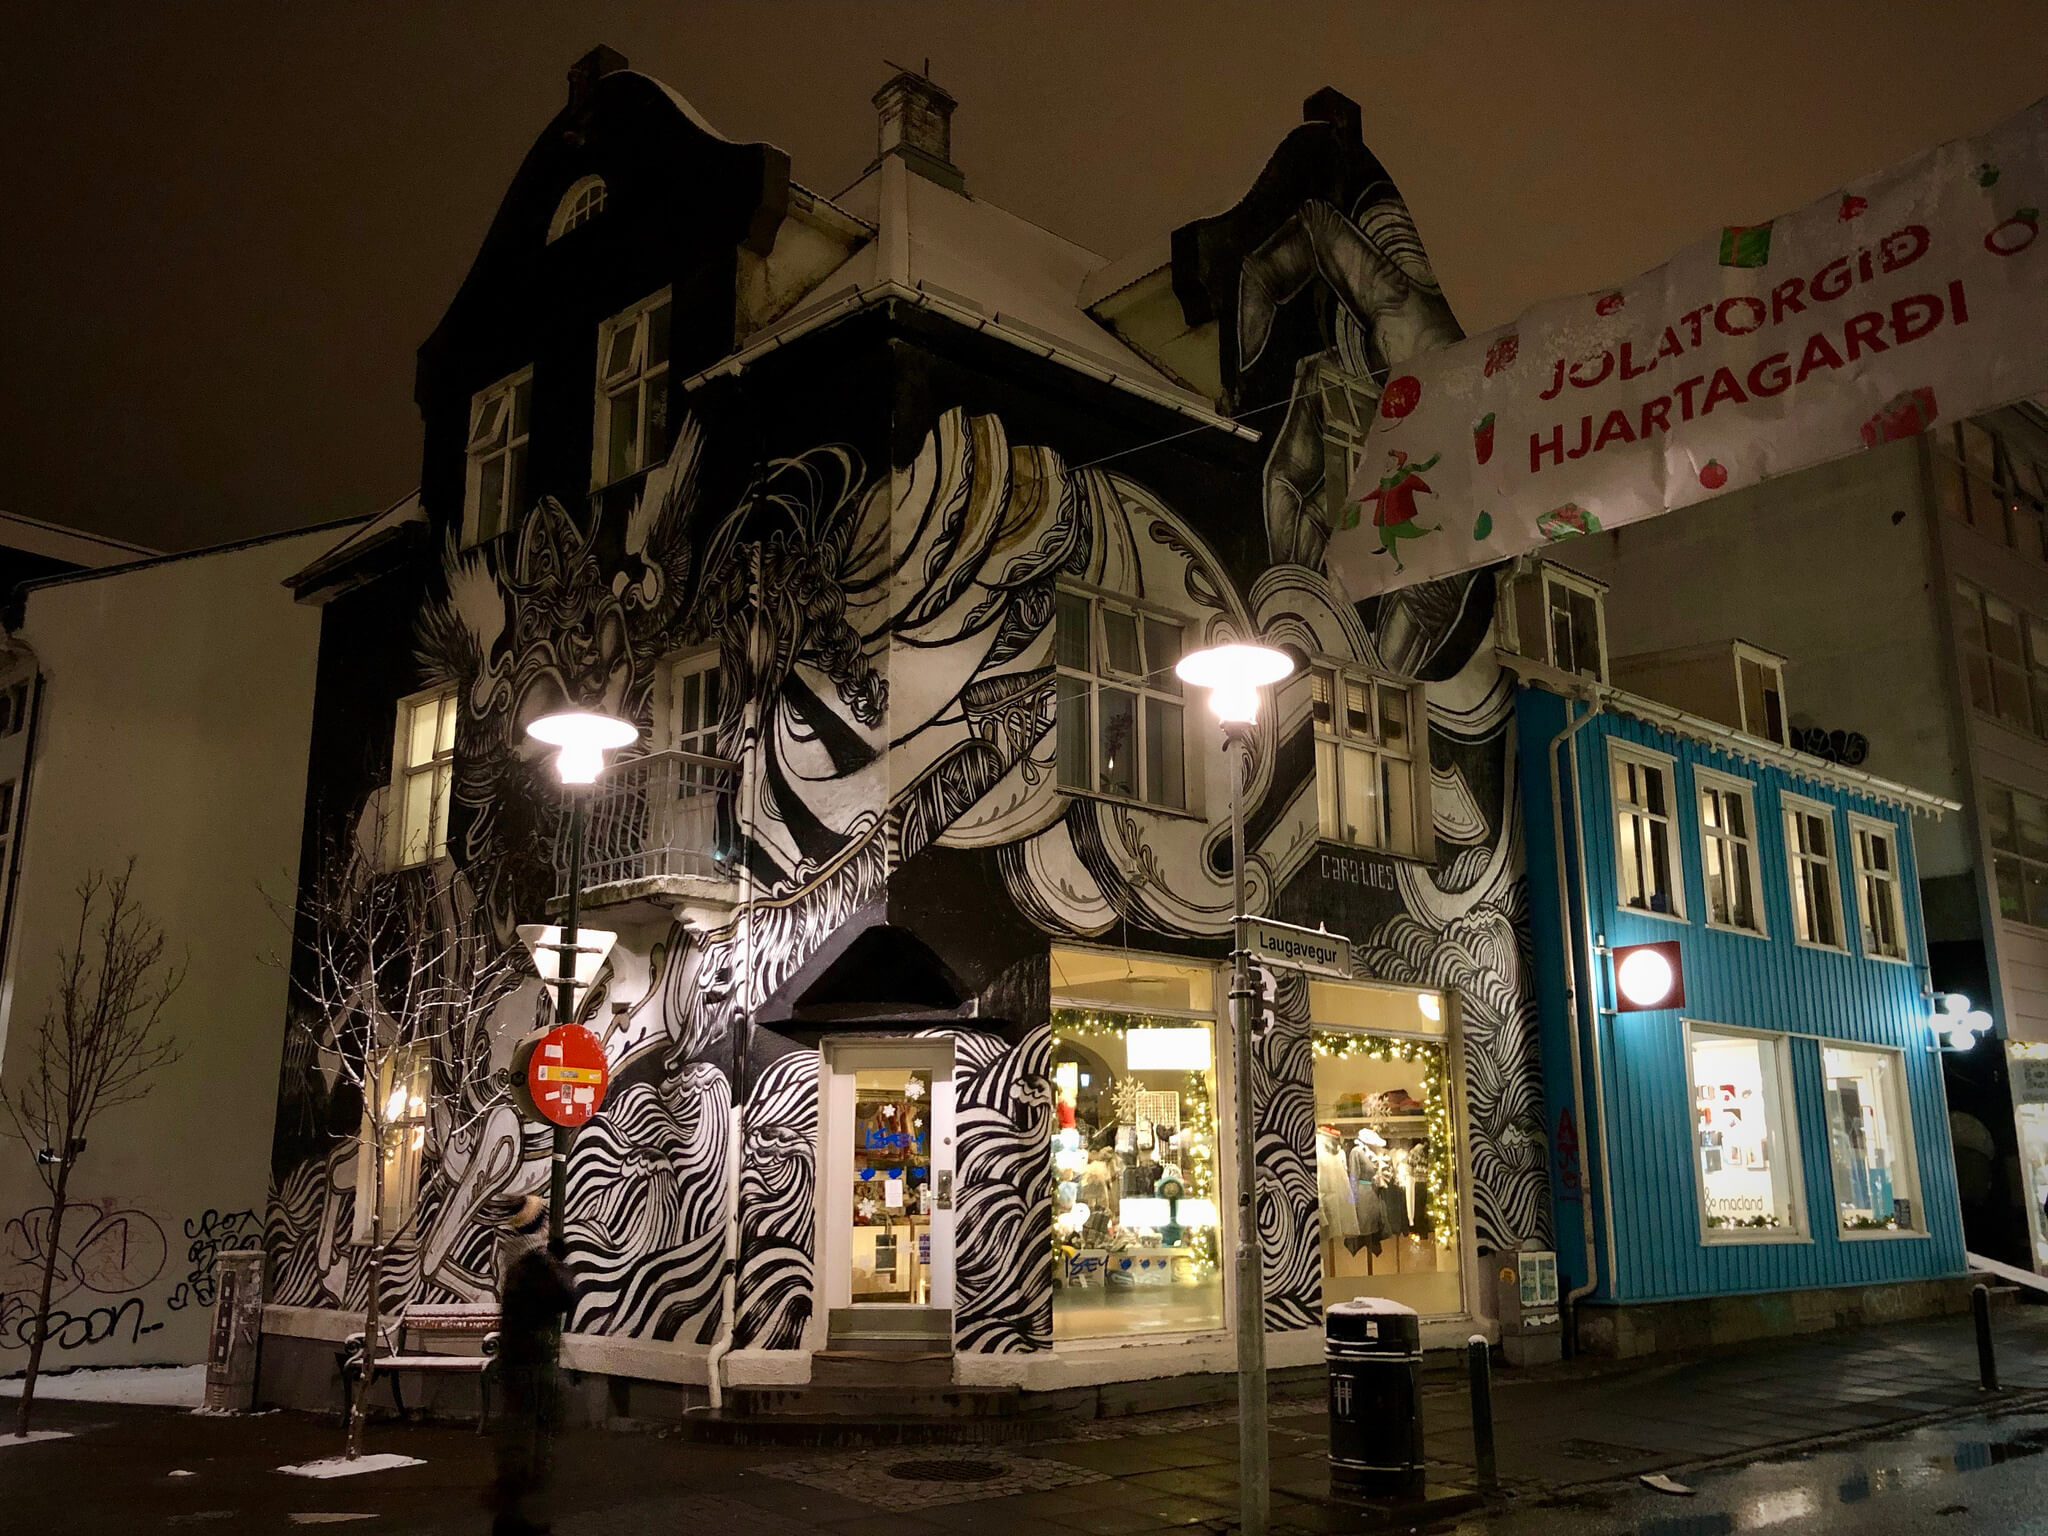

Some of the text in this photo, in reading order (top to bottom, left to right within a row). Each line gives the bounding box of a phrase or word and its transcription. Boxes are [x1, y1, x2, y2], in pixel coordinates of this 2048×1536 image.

[1530, 279, 1969, 473] HJARTAGARÐI
[1259, 931, 1338, 965] Laugavegur
[1719, 1195, 1764, 1212] macland
